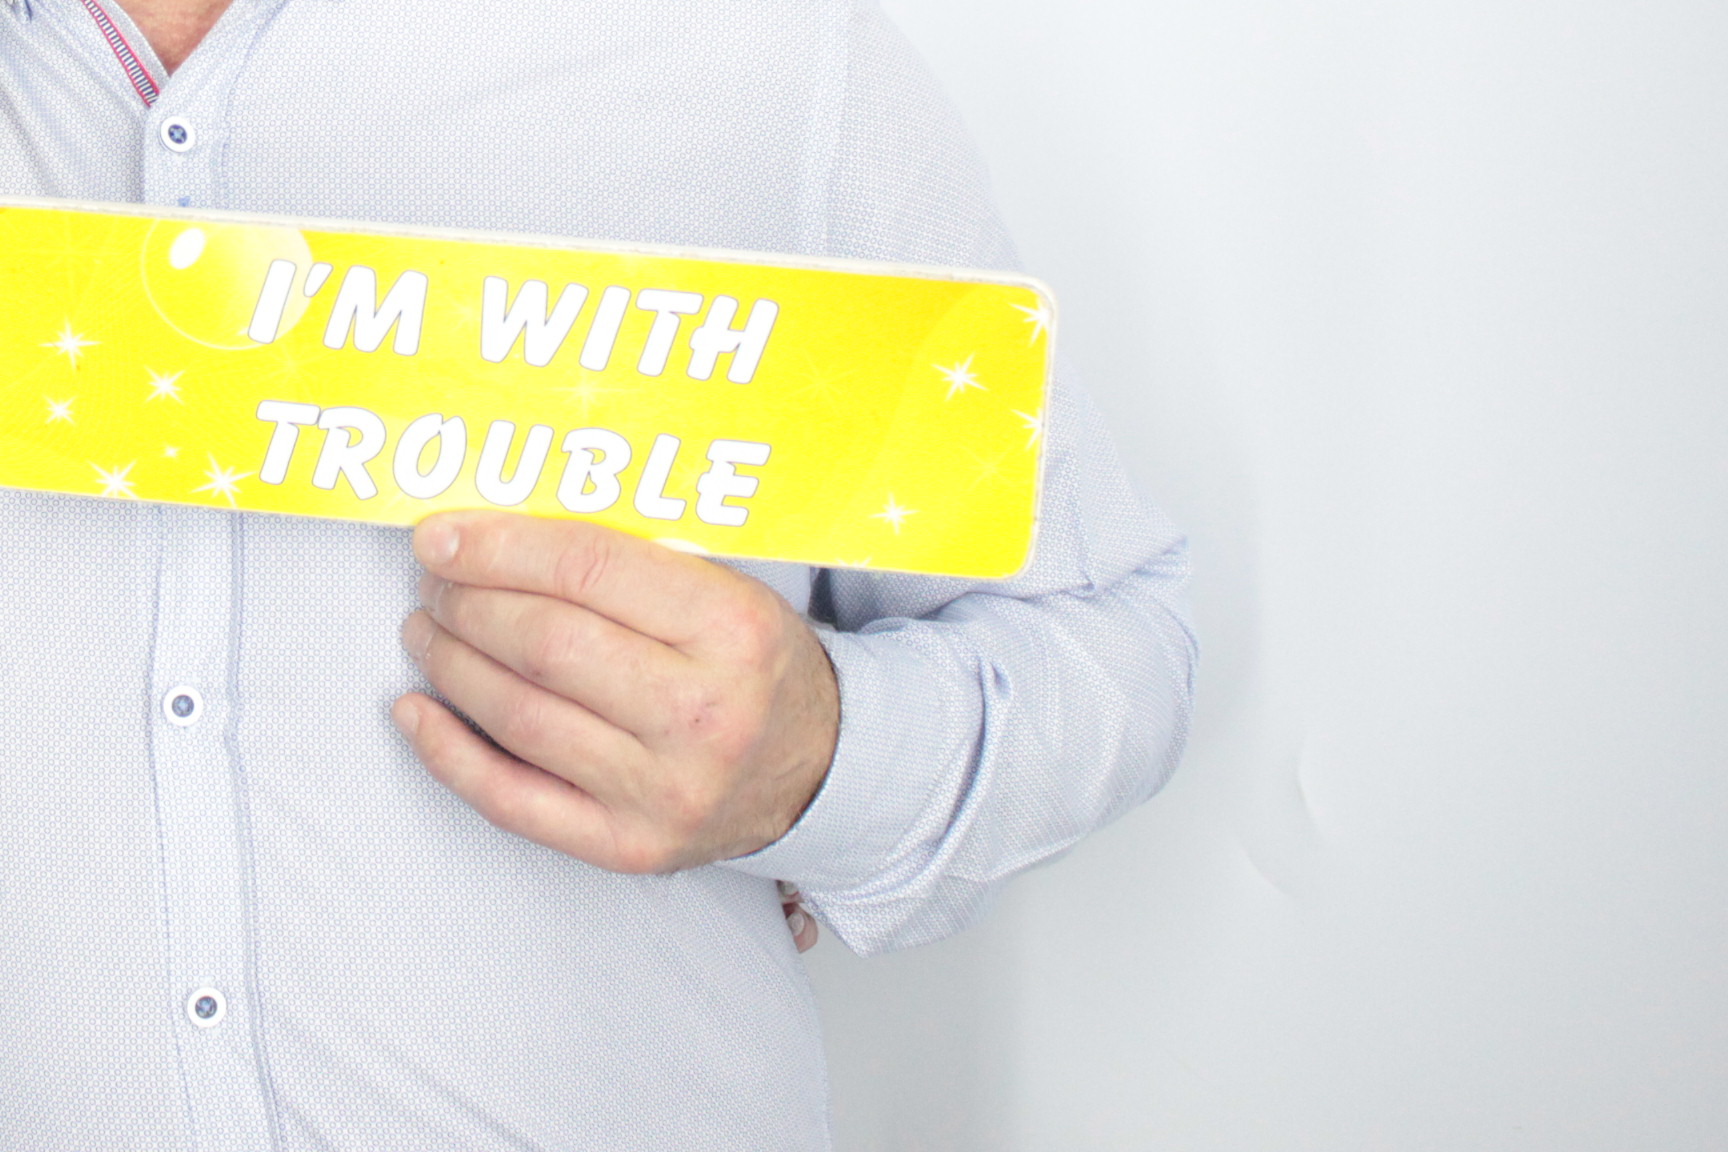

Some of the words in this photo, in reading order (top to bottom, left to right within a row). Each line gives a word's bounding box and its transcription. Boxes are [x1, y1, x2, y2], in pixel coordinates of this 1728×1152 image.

[246, 258, 429, 357] I'M
[479, 274, 780, 385] WITH
[254, 399, 773, 528] TROUBLE
